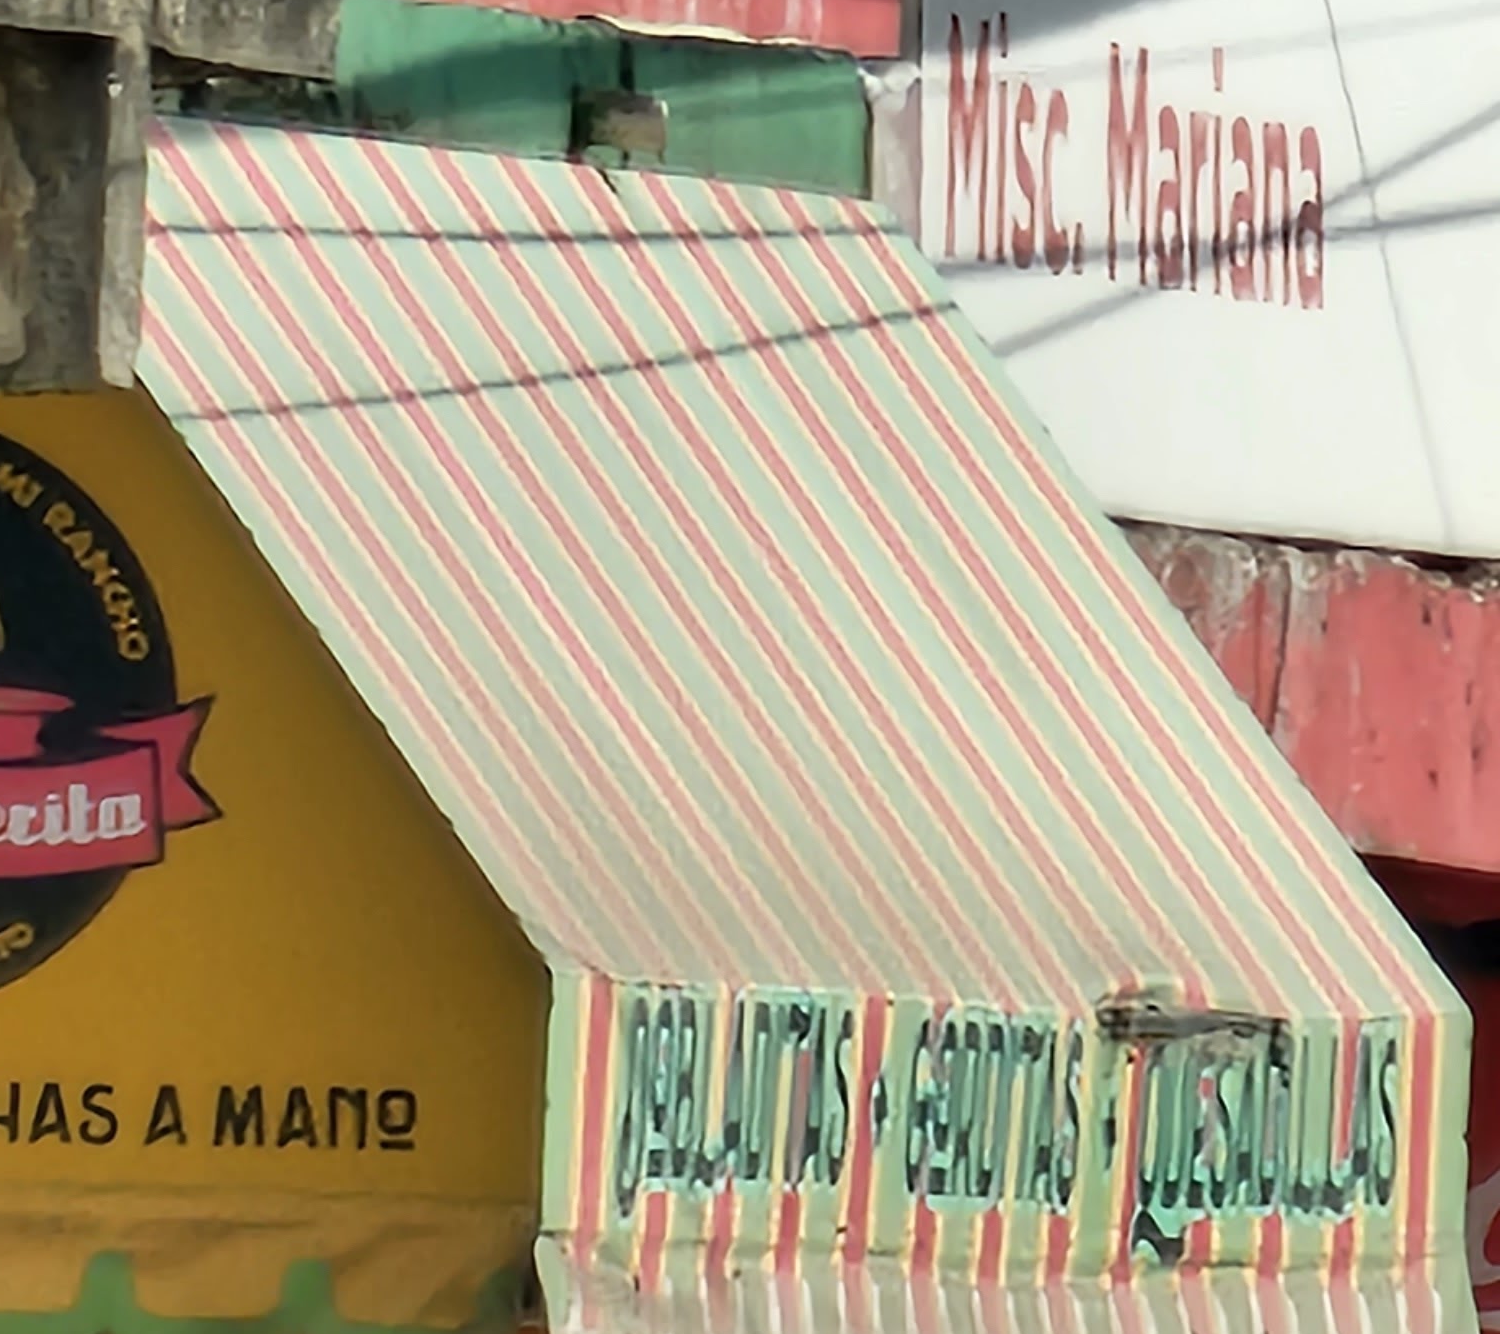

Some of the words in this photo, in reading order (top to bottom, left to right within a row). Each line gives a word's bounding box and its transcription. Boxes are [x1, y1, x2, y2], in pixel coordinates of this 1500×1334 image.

[943, 11, 1085, 276] Misc.
[1107, 41, 1325, 310] Mariana
[41, 500, 151, 662] RANCHO
[142, 1084, 188, 1147] A
[212, 1083, 419, 1151] MANO
